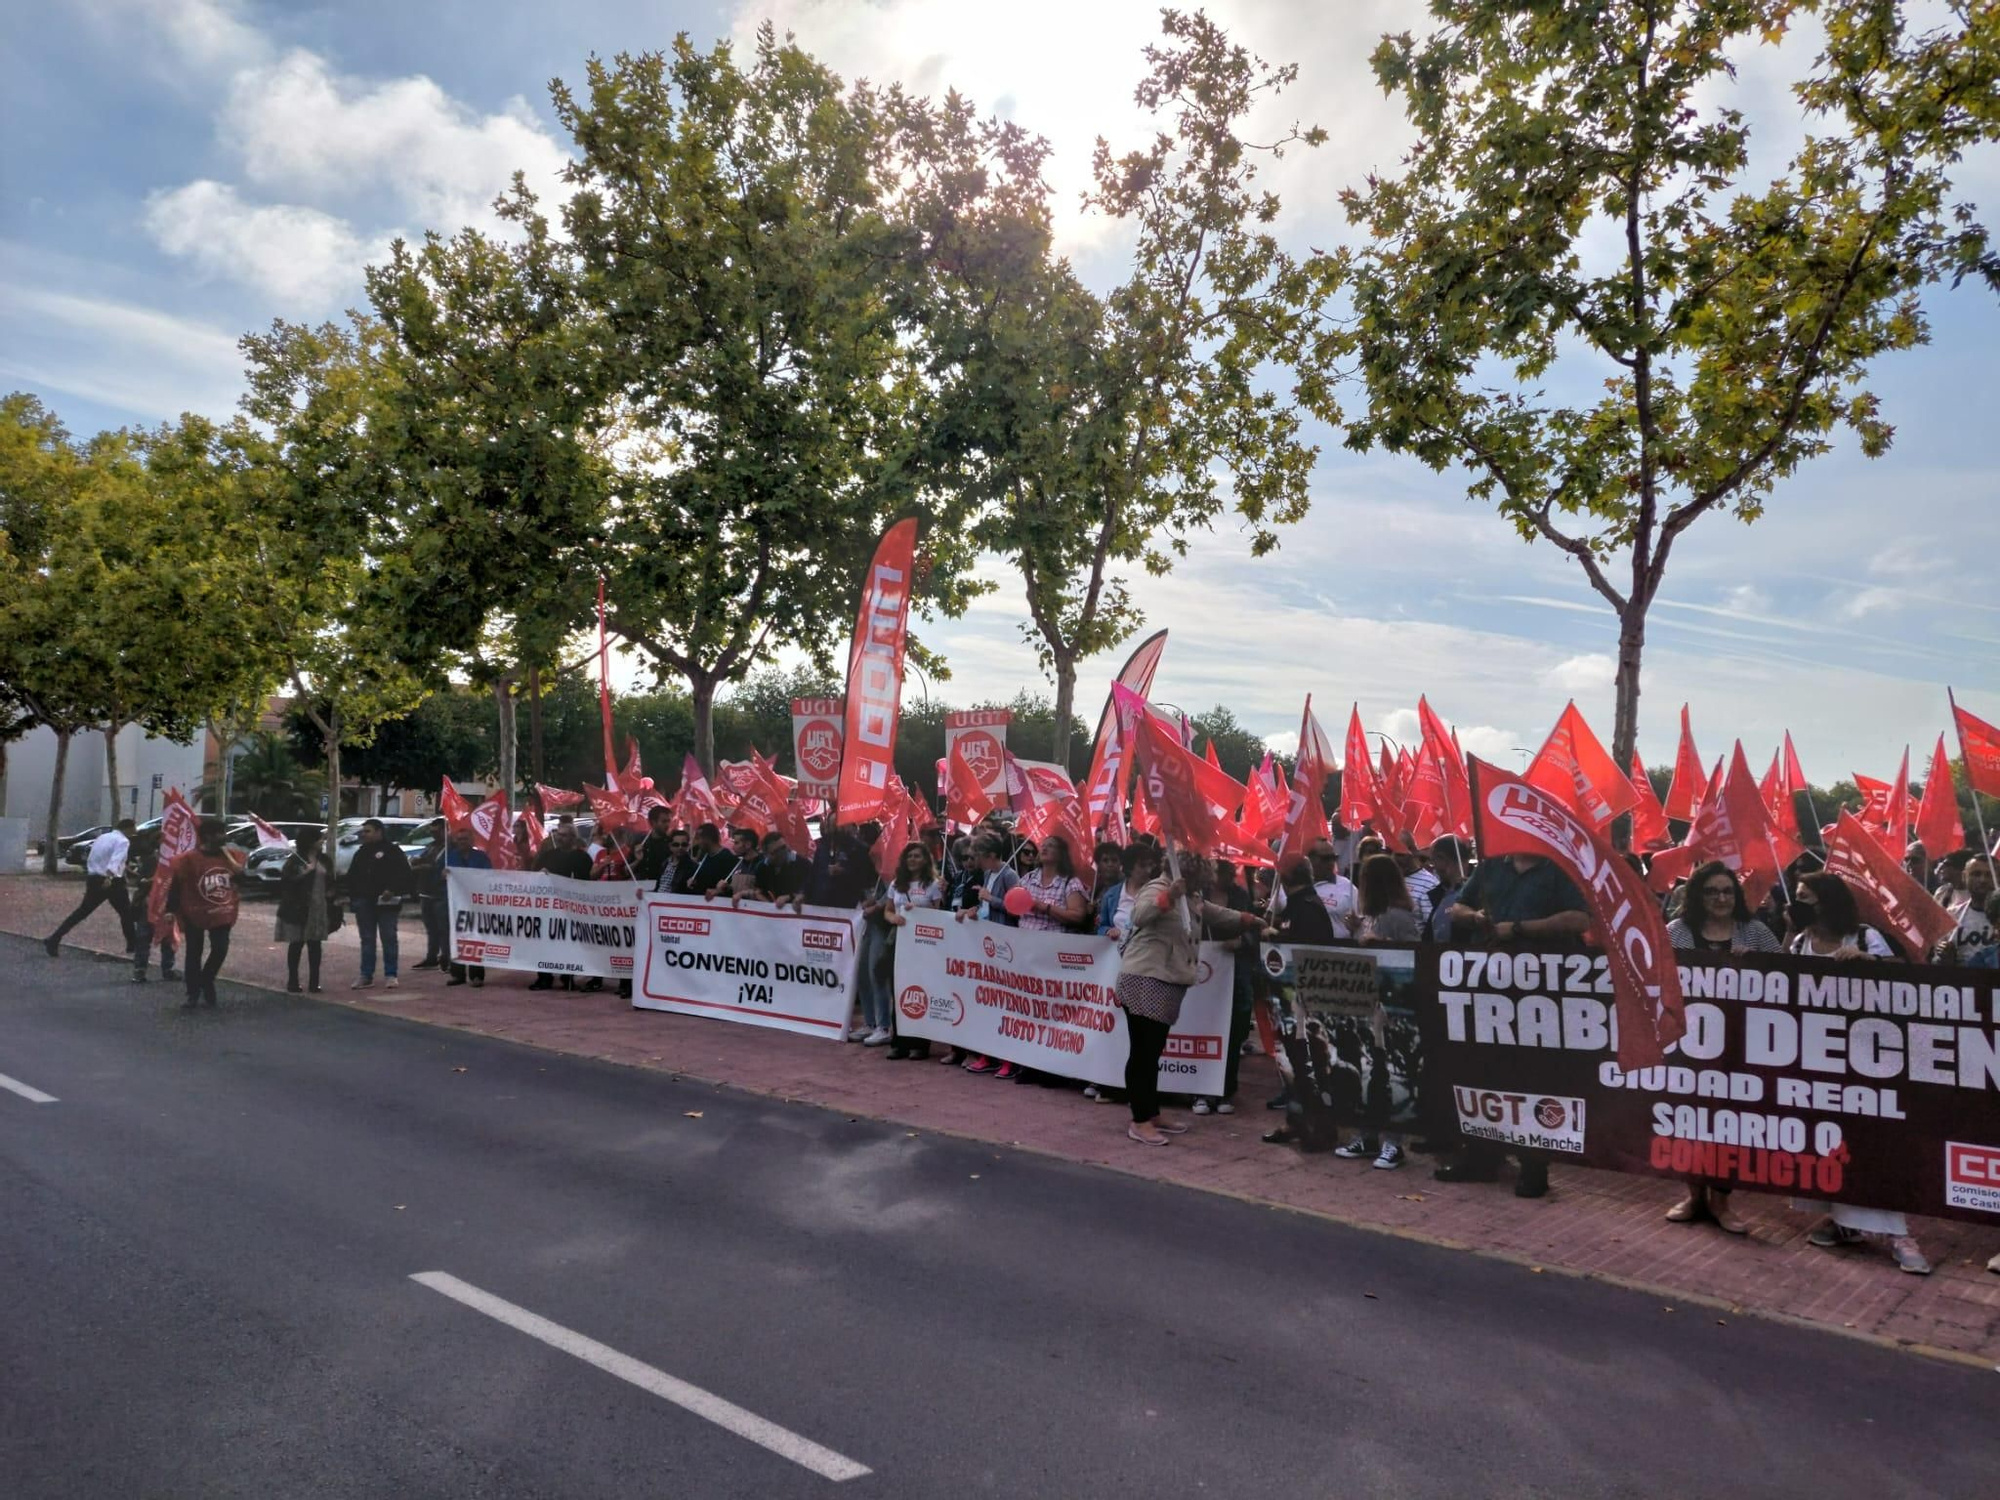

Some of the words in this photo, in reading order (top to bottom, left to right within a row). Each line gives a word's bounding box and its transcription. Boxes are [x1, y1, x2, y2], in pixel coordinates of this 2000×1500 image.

[801, 700, 837, 715] UGT
[956, 709, 994, 727] UGT
[806, 729, 834, 751] UGT
[961, 740, 991, 759] UGT
[806, 784, 838, 799] UGT
[504, 884, 558, 896] TRABAJADORA
[471, 893, 484, 905] DE
[486, 894, 532, 908] LIMPIEZA
[534, 898, 549, 909] DE
[589, 907, 596, 916] Y
[456, 910, 475, 933] EN
[478, 912, 514, 937] LUCHA
[517, 916, 542, 939] POR
[548, 917, 567, 941] UN
[570, 921, 621, 948] CONVENIO
[659, 919, 695, 932] CCOO
[803, 933, 831, 947] CCOO
[537, 961, 564, 971] CIUDAD
[566, 963, 584, 972] REAL
[665, 950, 769, 979] CONVENIO
[775, 963, 845, 993] DIGNO,
[1298, 957, 1372, 976] JUSTICIA
[945, 957, 966, 978] LOS
[967, 961, 1044, 996] TRABAJADORES
[1045, 979, 1064, 998] EN
[1065, 981, 1104, 1005] LUCHA
[1297, 975, 1378, 993] SALARIAL
[738, 983, 774, 1004] ¡YA!
[906, 990, 926, 1002] UGT
[1676, 965, 1790, 1004] RNADA
[1797, 973, 1983, 1022] MUNDIAL
[975, 985, 1031, 1016] CONVENIO
[1032, 999, 1050, 1021] DE
[1051, 1003, 1116, 1034] COMERCIO
[997, 1015, 1036, 1042] JUSTO
[1037, 1024, 1046, 1046] Y
[1046, 1026, 1085, 1056] DIGNO
[1438, 991, 1726, 1060] TRABO
[1744, 1006, 2000, 1091] DECEN
[1157, 1060, 1198, 1074] vicios
[1599, 1061, 1764, 1101] CIUDAD
[1777, 1076, 1906, 1120] REAL
[1456, 1088, 1527, 1126] UGT
[1461, 1121, 1527, 1145] Castilla-La
[1529, 1133, 1583, 1152] Mancha
[1652, 1101, 1807, 1154] SALARIO
[1815, 1121, 1844, 1157] O
[1650, 1136, 1845, 1194] CONFLICTO
[1952, 1195, 1967, 1204] de
